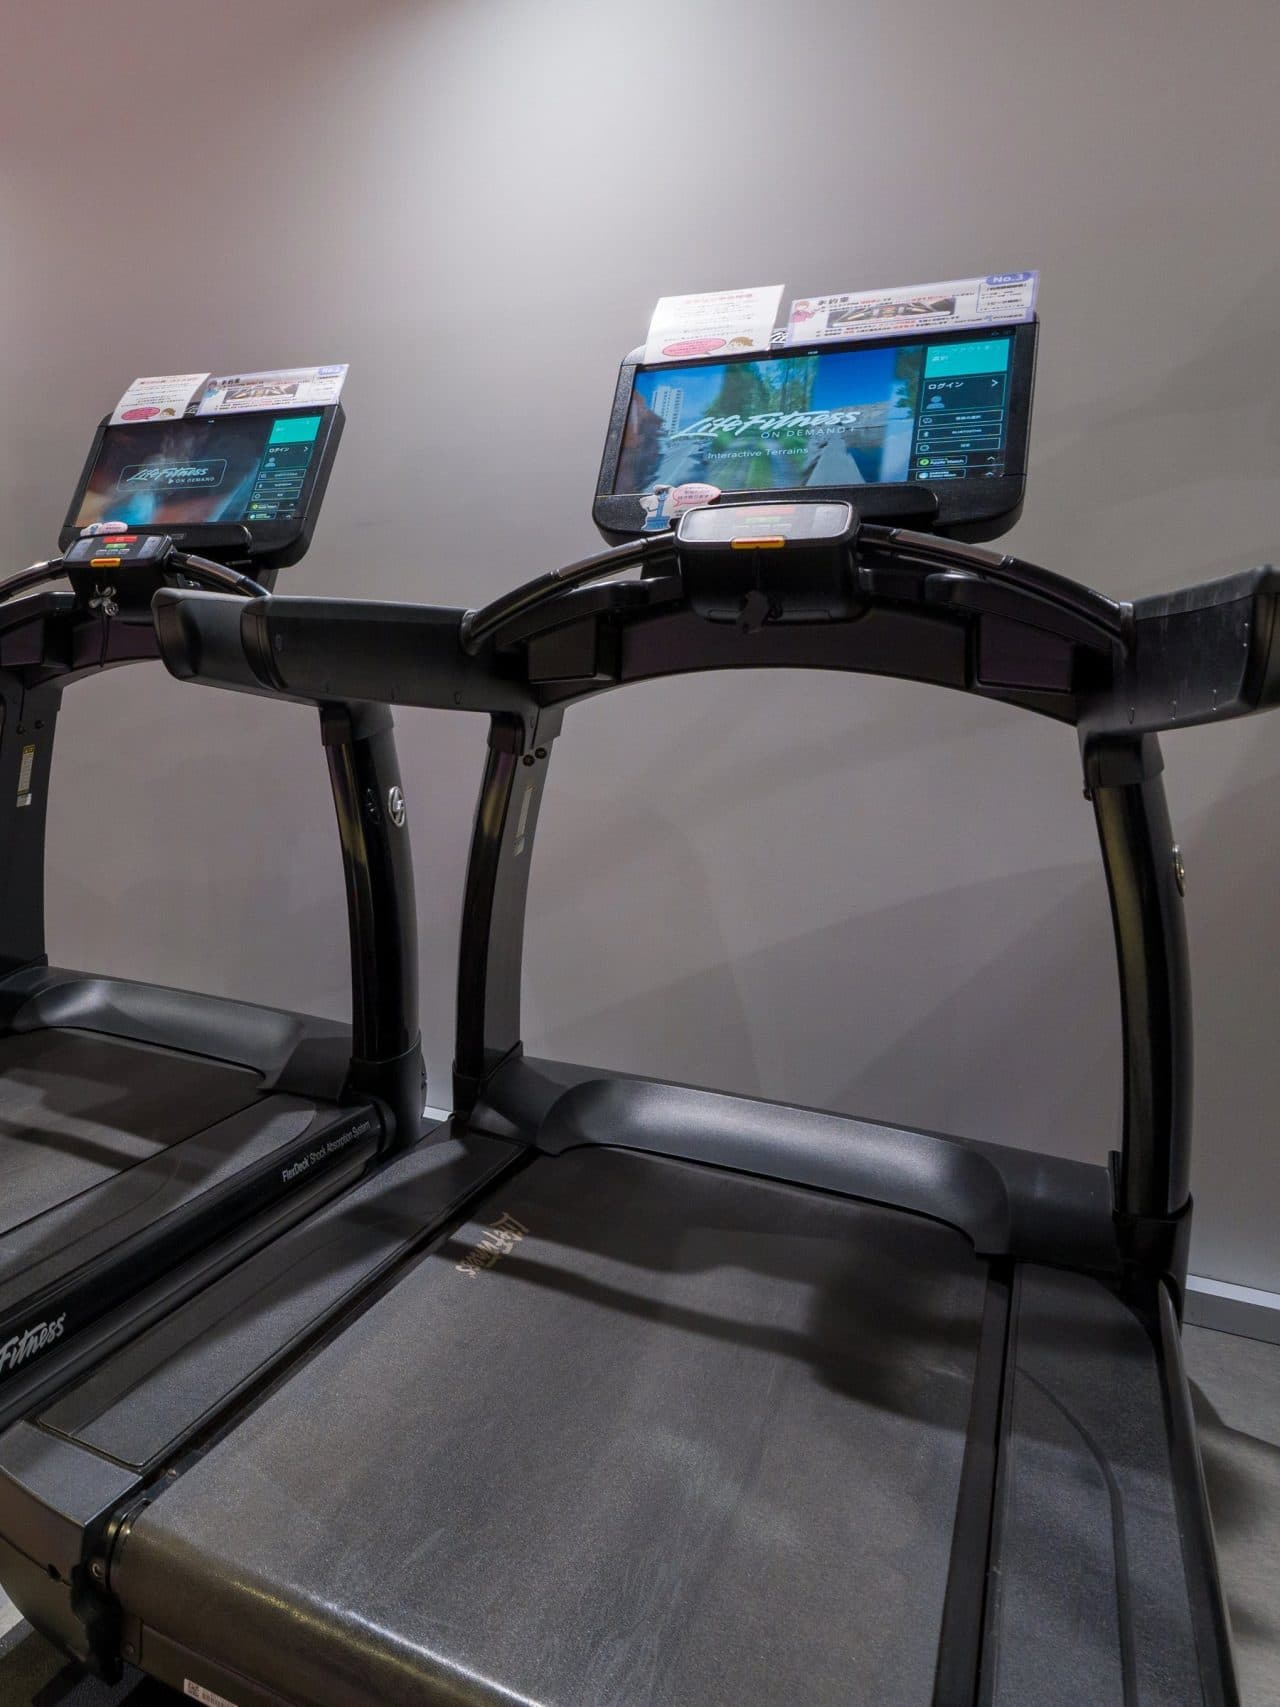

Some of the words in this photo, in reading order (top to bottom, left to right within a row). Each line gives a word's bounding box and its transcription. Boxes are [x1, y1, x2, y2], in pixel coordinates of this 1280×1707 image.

[928, 381, 964, 390] ログイン
[760, 431, 780, 440] ON
[707, 450, 762, 460] Interactive
[765, 448, 809, 456] Terrains
